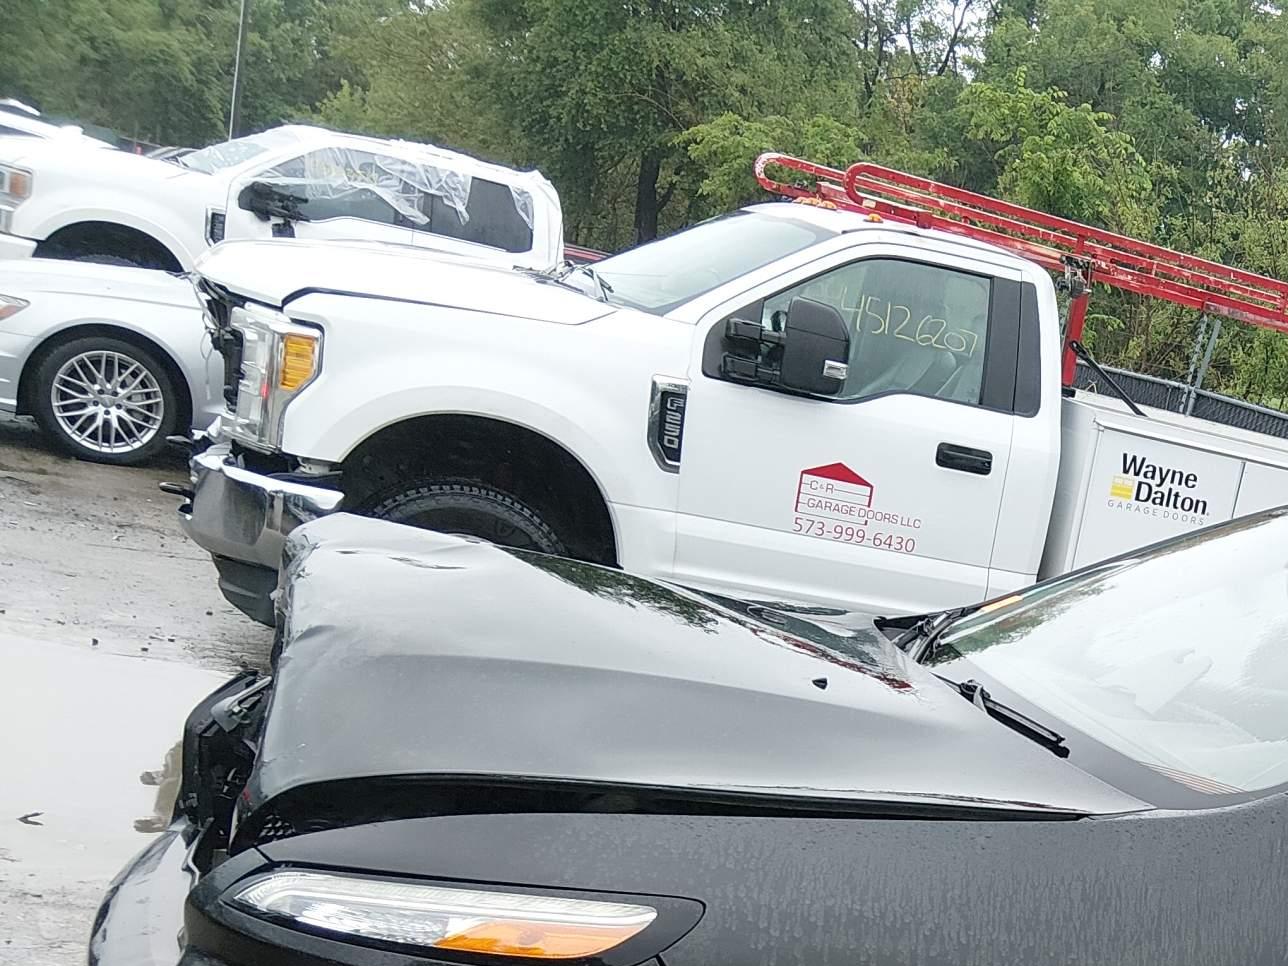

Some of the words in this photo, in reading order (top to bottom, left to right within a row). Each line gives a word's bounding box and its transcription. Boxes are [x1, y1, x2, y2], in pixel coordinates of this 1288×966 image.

[841, 287, 978, 357] 45126207
[1122, 453, 1198, 488] Wayne
[806, 498, 856, 517] GARAGE
[857, 507, 899, 525] DOORS
[900, 517, 922, 529] LLC
[1107, 499, 1158, 517] GARAGE
[1163, 510, 1204, 526] DOORS
[1134, 480, 1208, 516] Dalton
[793, 516, 916, 553] 573-999-6430
